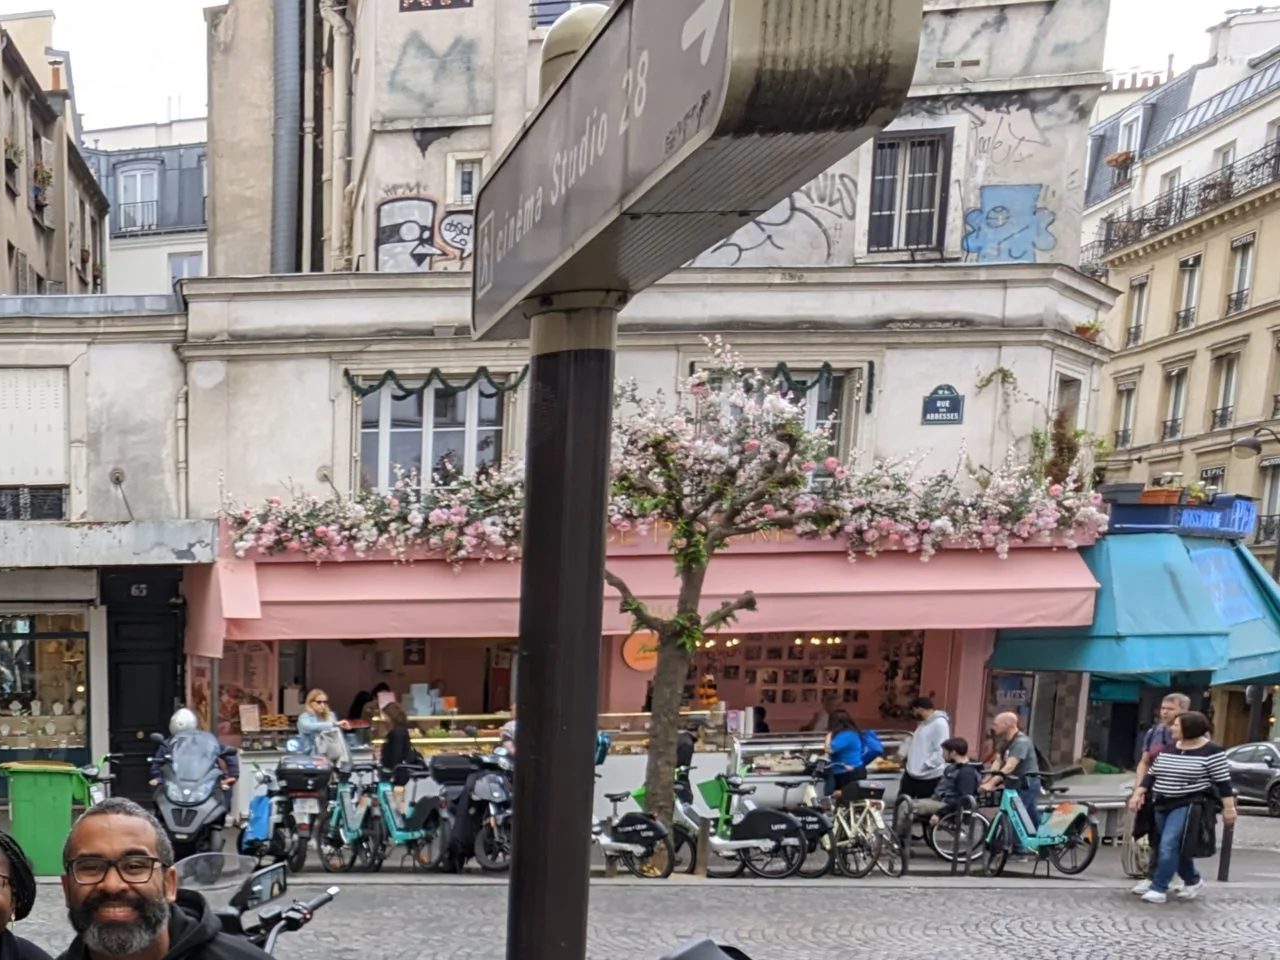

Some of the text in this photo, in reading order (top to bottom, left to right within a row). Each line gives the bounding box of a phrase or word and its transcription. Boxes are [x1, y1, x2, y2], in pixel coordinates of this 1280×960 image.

[496, 50, 648, 262] cinéma Studio 28
